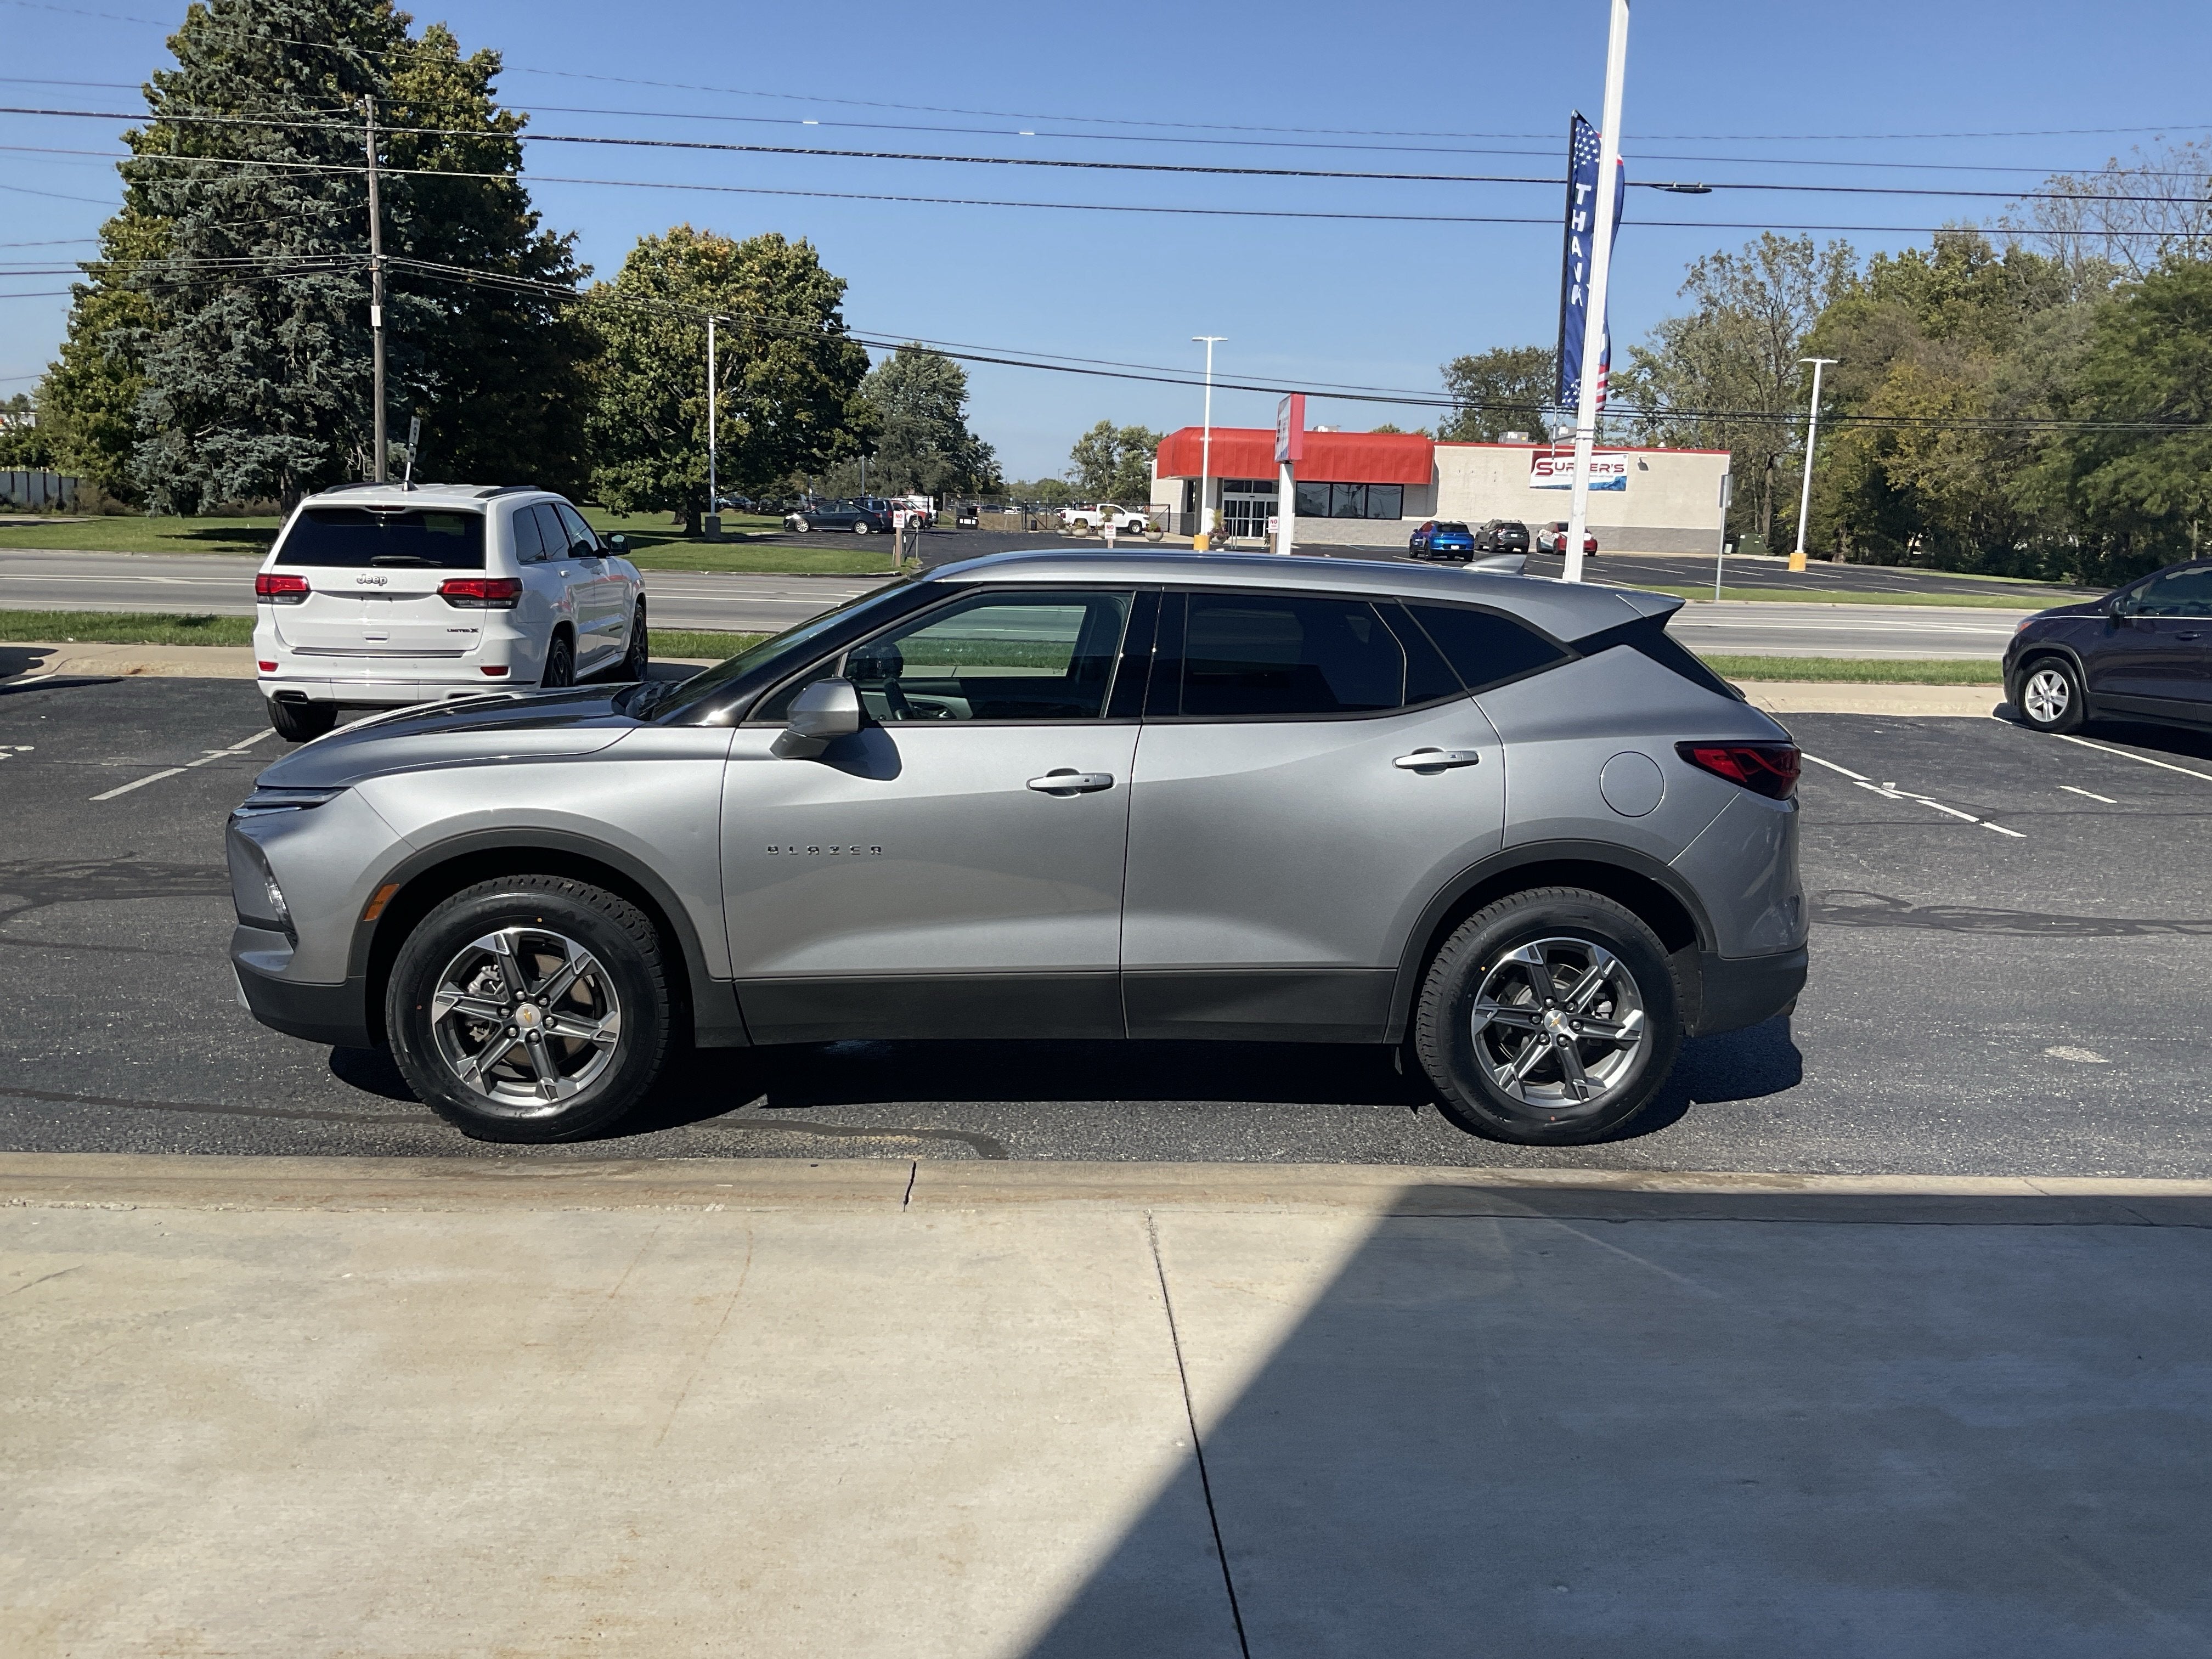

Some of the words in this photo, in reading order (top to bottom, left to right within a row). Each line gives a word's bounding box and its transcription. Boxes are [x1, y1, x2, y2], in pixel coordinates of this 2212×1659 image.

[1535, 462, 1624, 476] SURER'S
[357, 574, 387, 586] Jeep
[768, 846, 882, 855] BLAZER
